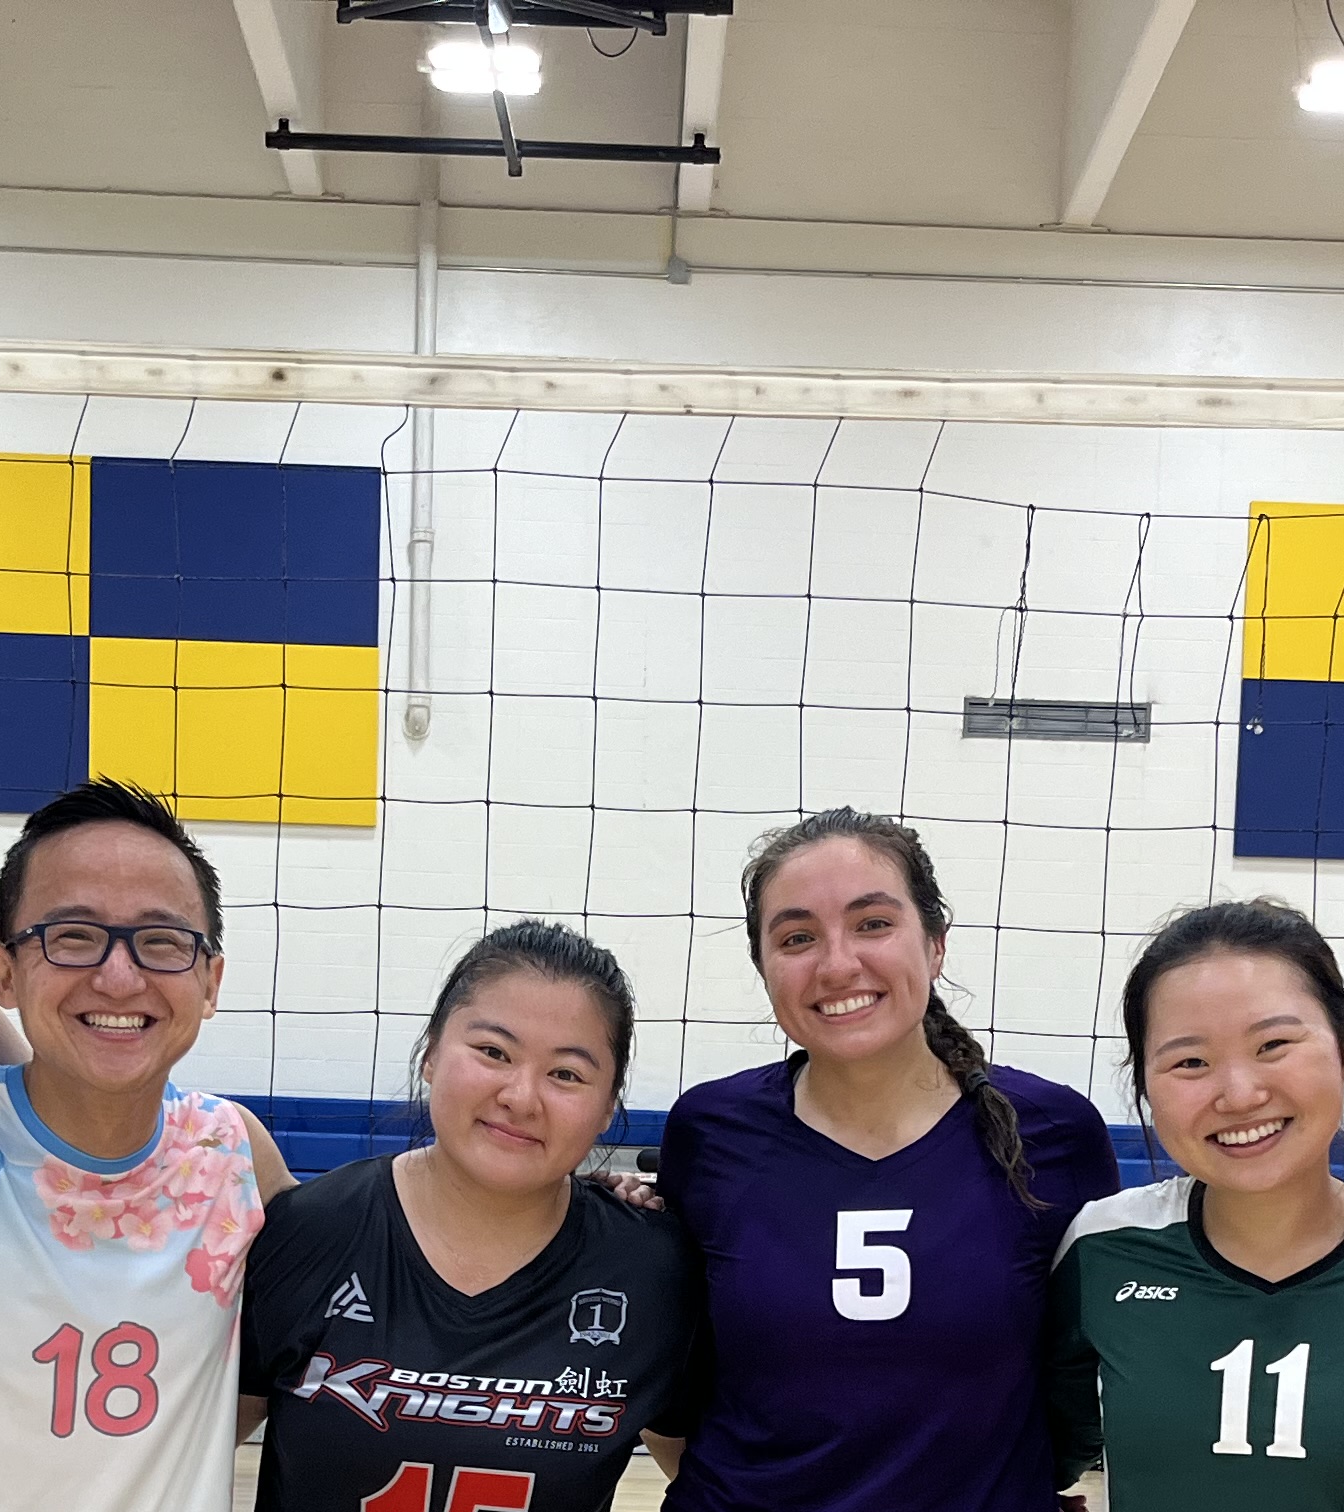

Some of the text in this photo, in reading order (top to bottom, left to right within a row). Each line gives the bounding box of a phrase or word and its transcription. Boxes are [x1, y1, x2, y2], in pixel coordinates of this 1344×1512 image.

[587, 1303, 605, 1330] 1
[831, 1208, 914, 1321] 5
[32, 1321, 159, 1438] 18
[1210, 1339, 1311, 1459] 11
[505, 1436, 599, 1453] ESTABLISHED 1961
